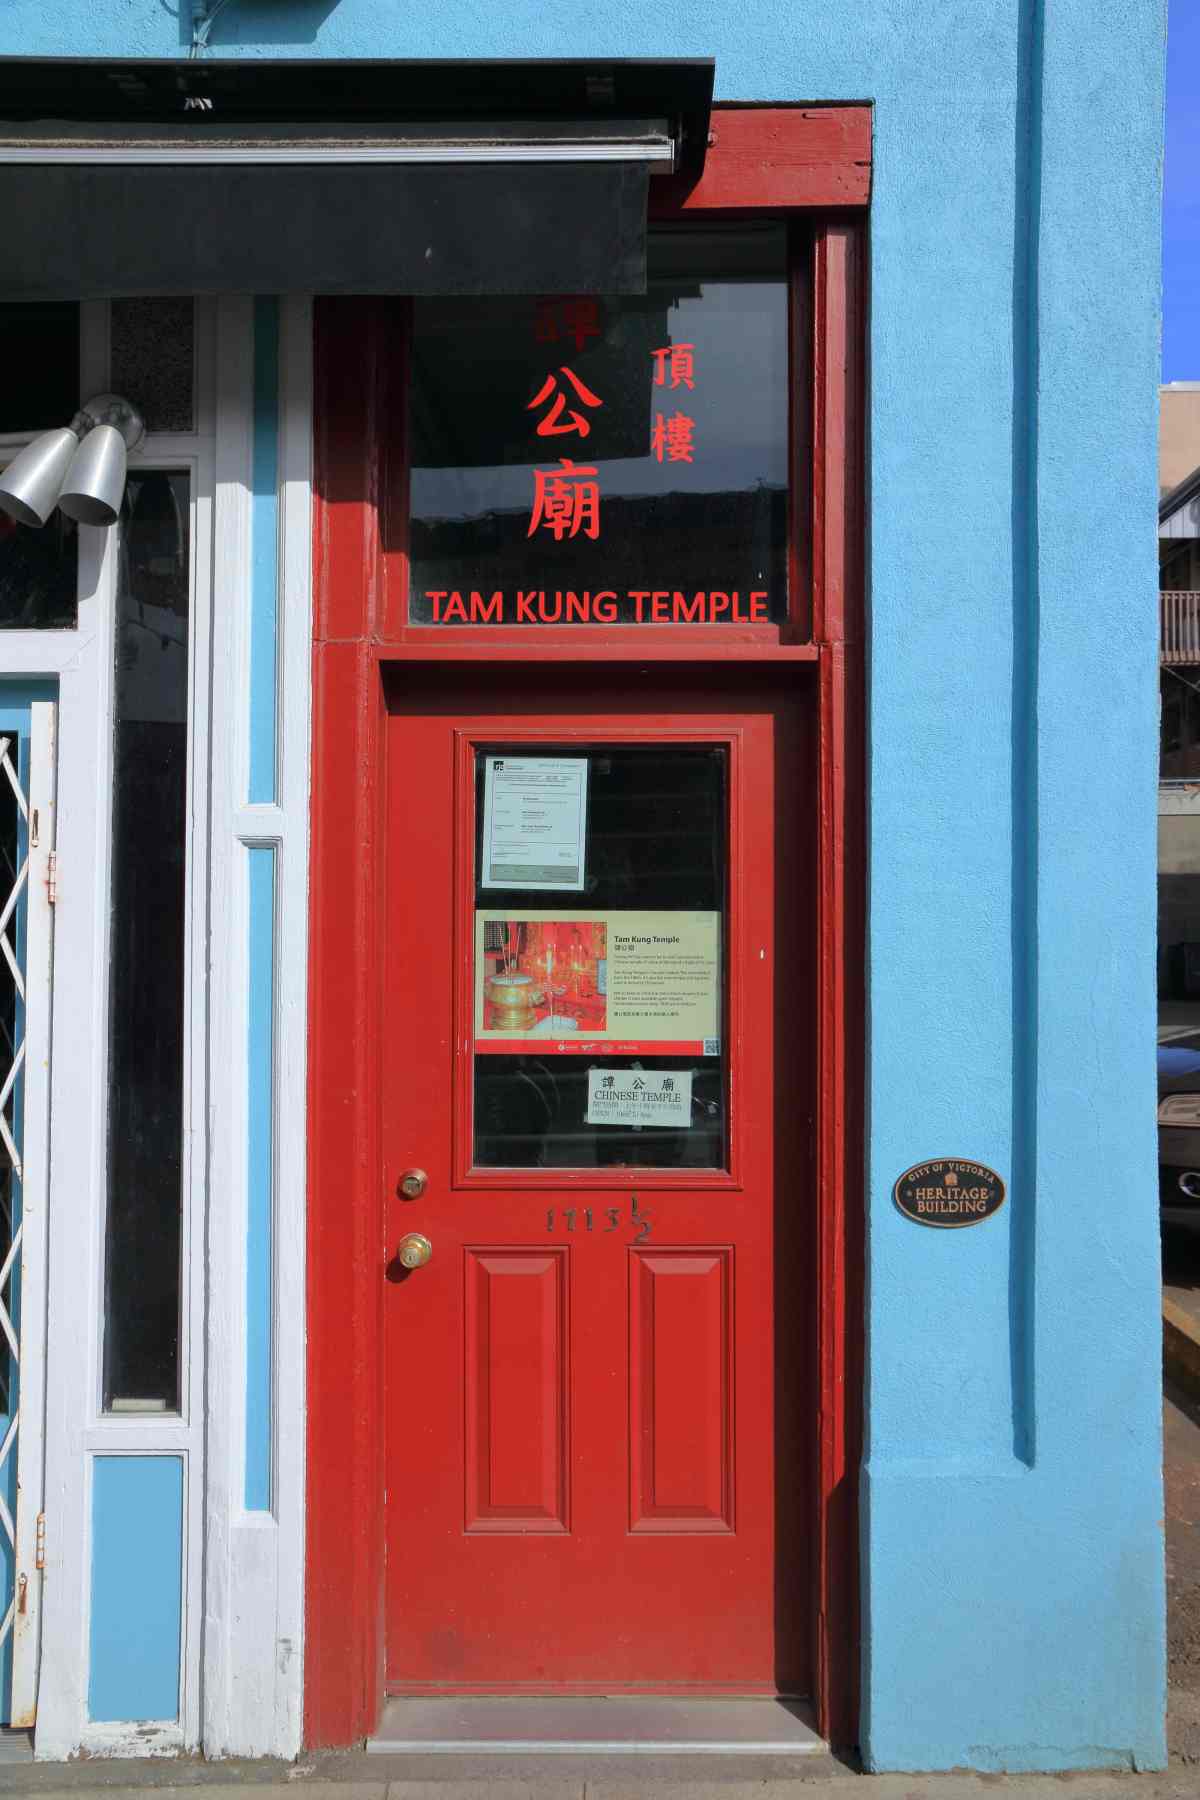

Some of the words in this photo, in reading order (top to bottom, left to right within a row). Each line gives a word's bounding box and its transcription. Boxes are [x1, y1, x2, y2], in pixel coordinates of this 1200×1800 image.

[650, 342, 696, 464] 頂樓
[426, 591, 503, 623] TAM
[517, 590, 617, 623] KUNG
[625, 591, 769, 623] TEMPLE
[632, 936, 651, 944] Kung
[652, 936, 680, 944] Temple
[594, 1090, 638, 1101] CHINESE
[641, 1092, 681, 1103] TEMPLE
[908, 1167, 930, 1182] CITY
[932, 1163, 943, 1172] OF
[948, 1163, 994, 1184] VICTORIA
[916, 1188, 989, 1200] HERITAGE
[918, 1201, 986, 1212] BUILDING
